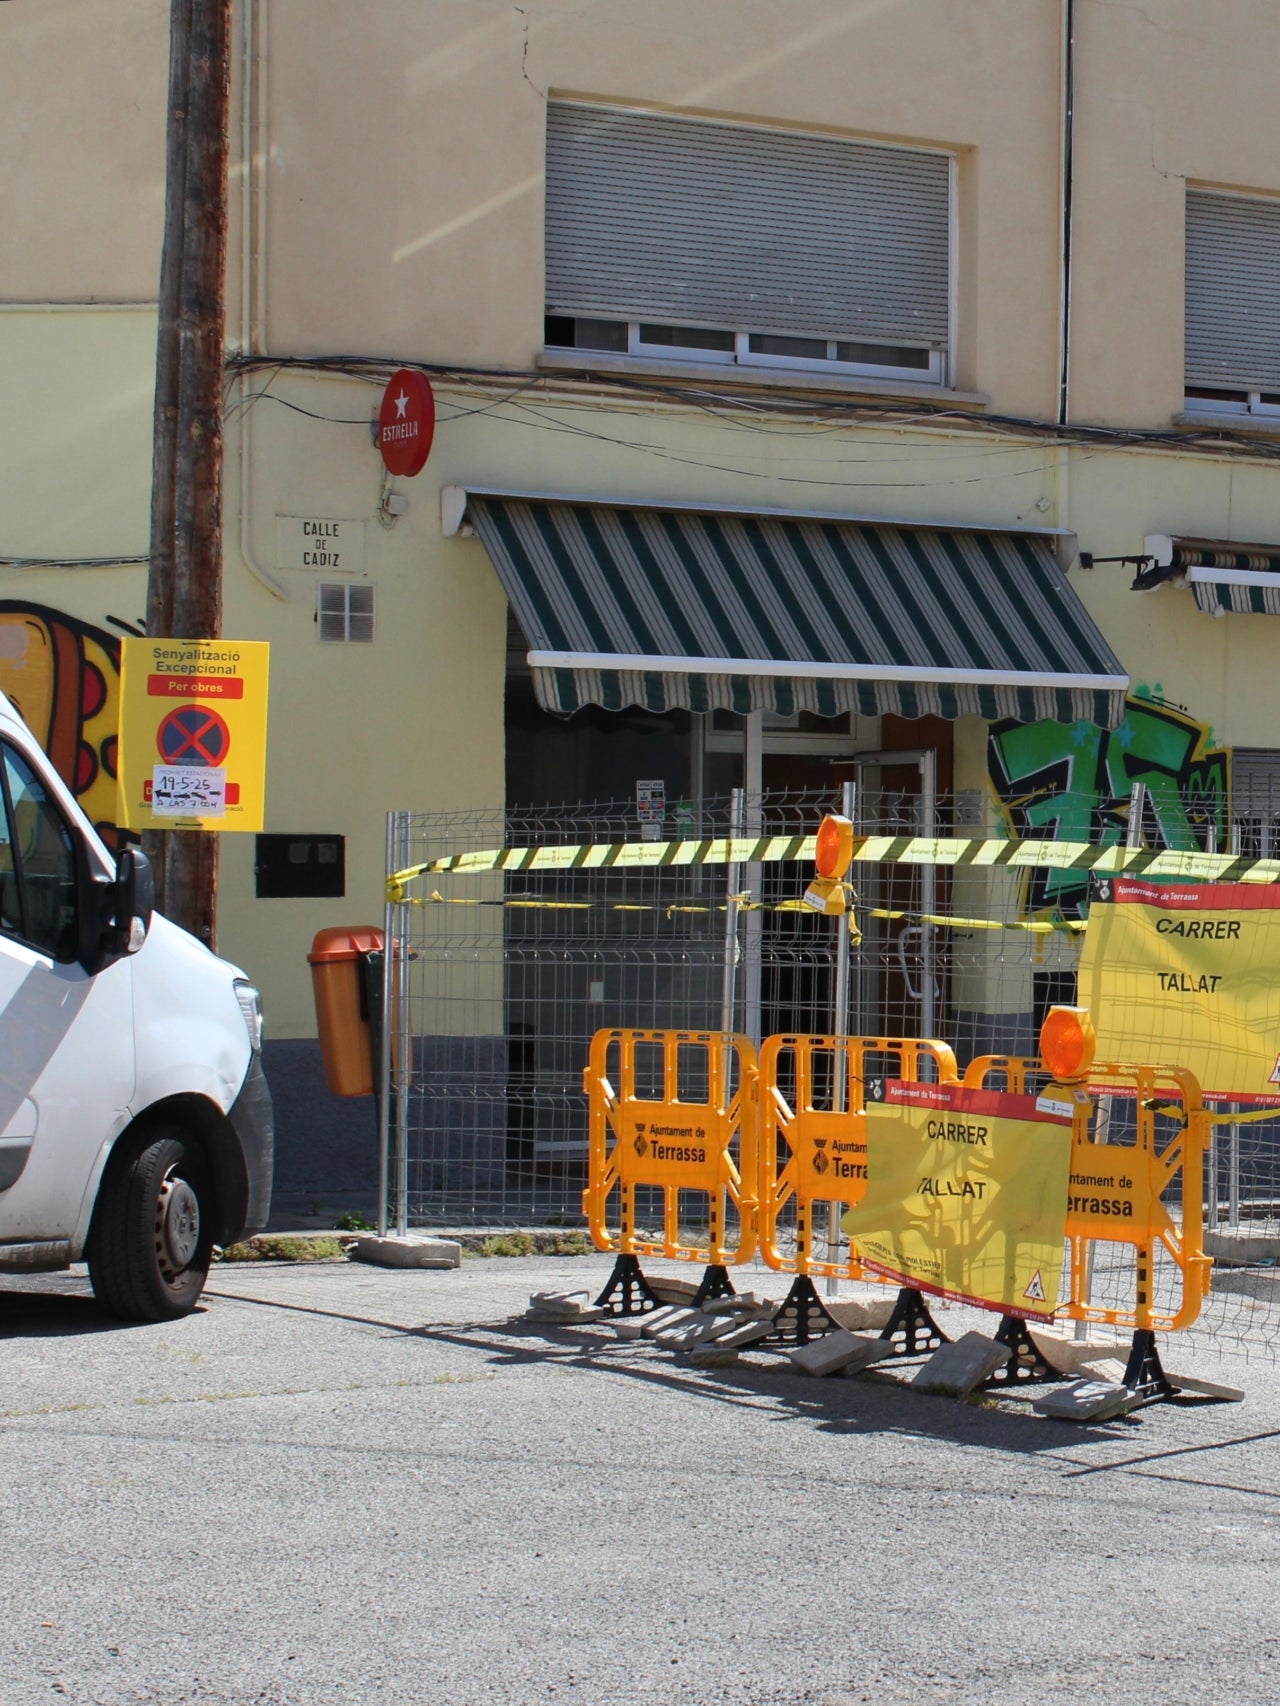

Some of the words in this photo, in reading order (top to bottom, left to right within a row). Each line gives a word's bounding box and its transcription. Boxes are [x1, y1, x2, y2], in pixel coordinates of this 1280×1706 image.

[383, 421, 418, 442] ESTRELLA
[303, 522, 340, 537] CALLE
[315, 539, 327, 550] DE
[303, 552, 340, 567] CADIZ
[153, 648, 240, 663] Senyalització
[156, 661, 236, 675] Excepcional
[168, 681, 188, 691] Per
[190, 682, 223, 693] obres
[1117, 886, 1159, 899] Ajuntament
[1160, 892, 1170, 901] de
[1170, 892, 1199, 901] Terrassa
[1155, 918, 1241, 940] CARRER
[1157, 972, 1223, 994] TALLAT
[890, 1086, 920, 1098] Ajuntament
[920, 1089, 928, 1099] de
[928, 1090, 951, 1102] Terrassa
[650, 1123, 693, 1137] Ajuntament
[695, 1126, 705, 1138] de
[927, 1120, 988, 1146] CARRER
[650, 1140, 706, 1162] Terrassa
[916, 1177, 987, 1200] TALLAT
[1118, 1175, 1133, 1189] de
